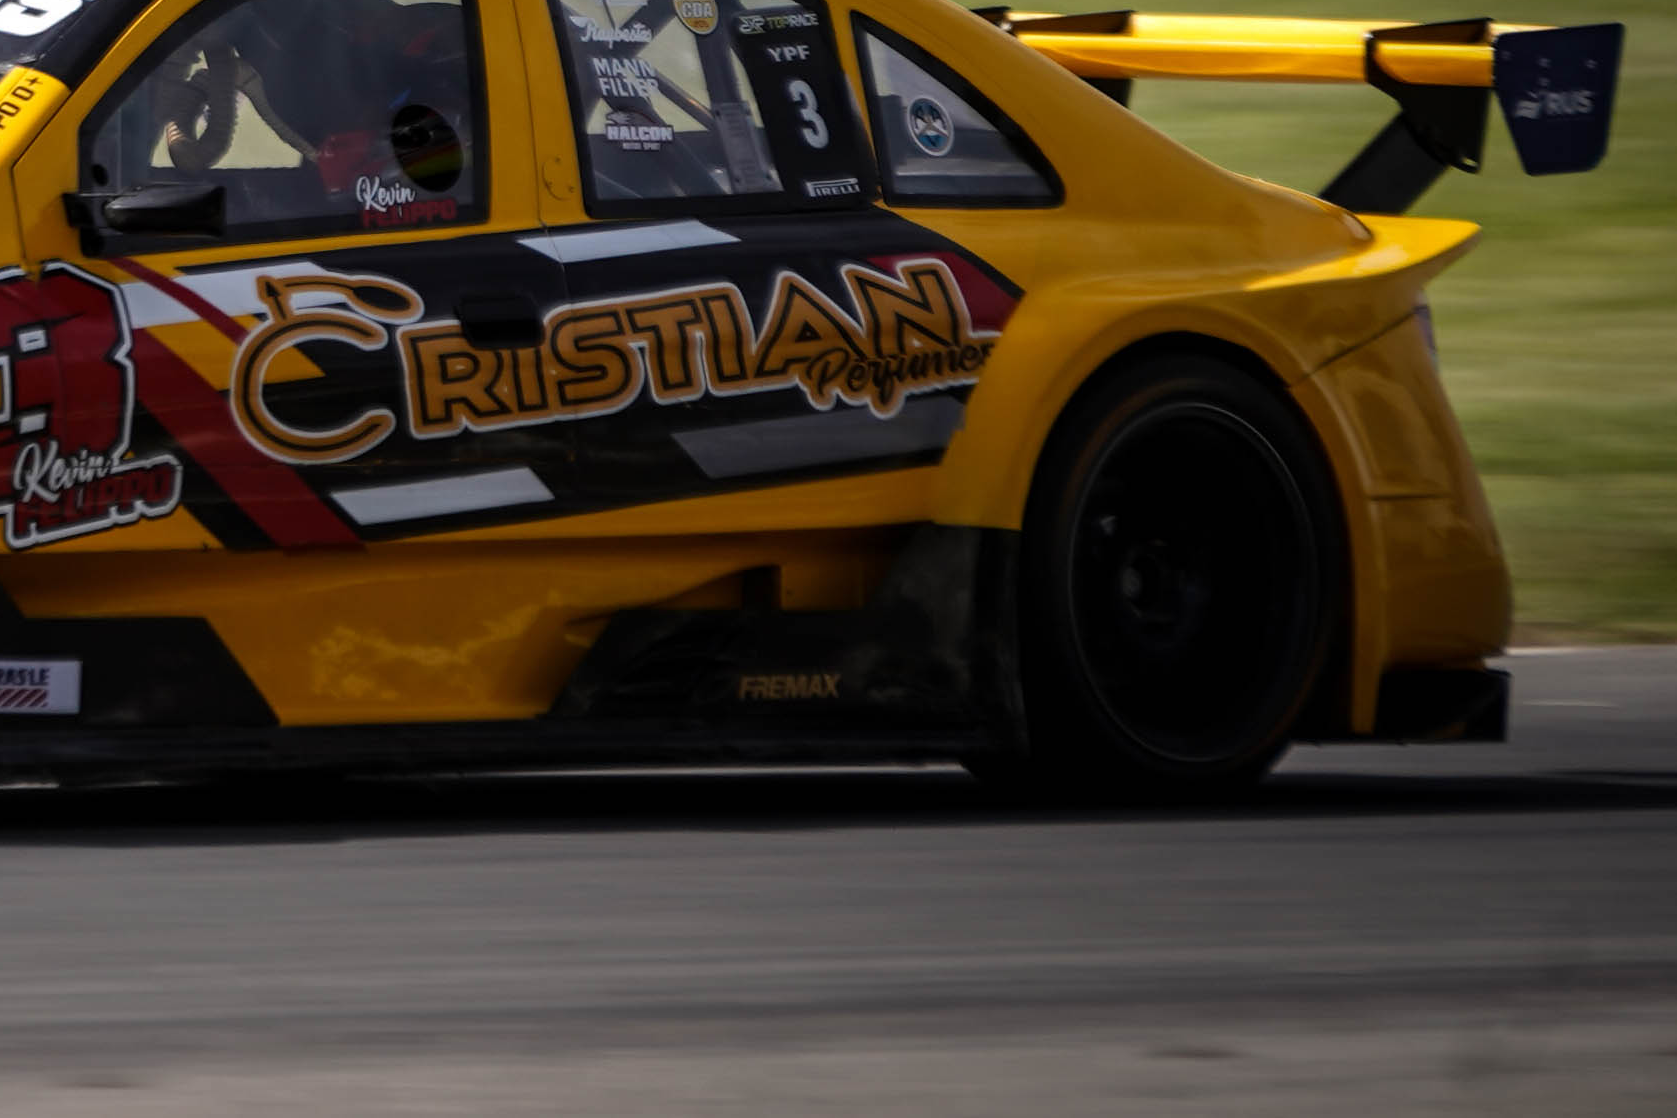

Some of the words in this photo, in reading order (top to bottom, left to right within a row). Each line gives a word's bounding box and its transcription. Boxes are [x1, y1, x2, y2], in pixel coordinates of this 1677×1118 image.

[767, 45, 811, 62] YPF
[592, 57, 656, 77] MANN
[598, 77, 659, 97] FILTER
[788, 80, 829, 149] 3
[356, 176, 416, 213] Kevin
[805, 178, 860, 197] PIRELLI
[13, 439, 121, 503] Kevin
[738, 674, 841, 699] FREMAX
